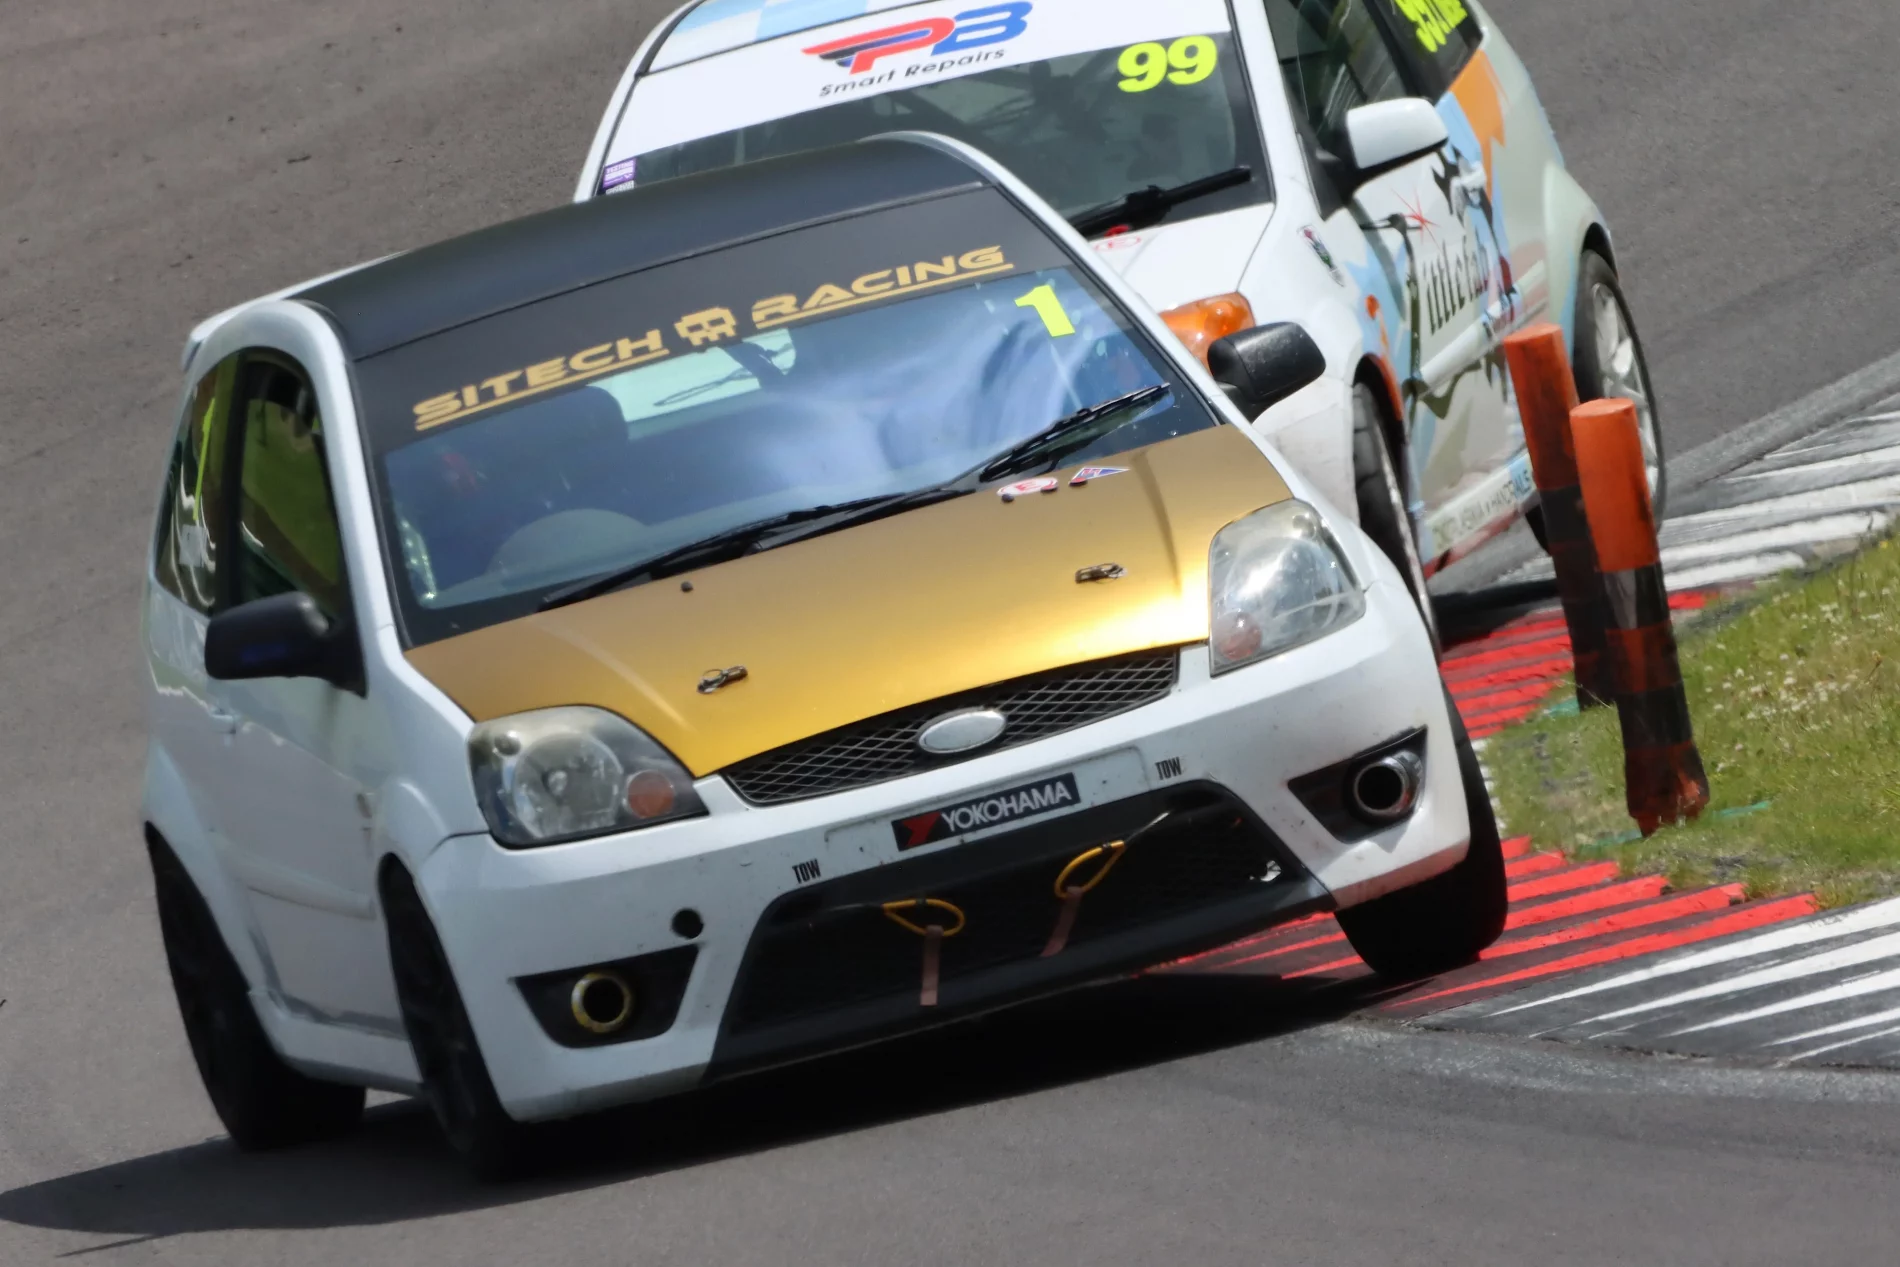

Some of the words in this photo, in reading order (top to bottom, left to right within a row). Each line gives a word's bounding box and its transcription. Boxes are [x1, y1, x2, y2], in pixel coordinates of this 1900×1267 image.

[819, 69, 896, 97] Smart
[904, 49, 1005, 77] Repairs
[1115, 34, 1218, 93] 99
[413, 330, 665, 422] SITECH
[752, 245, 1009, 328] RACING
[1014, 284, 1075, 337] 1
[1155, 757, 1182, 780] TOW
[941, 780, 1072, 833] YOKOHAMA
[792, 859, 821, 884] TOW
